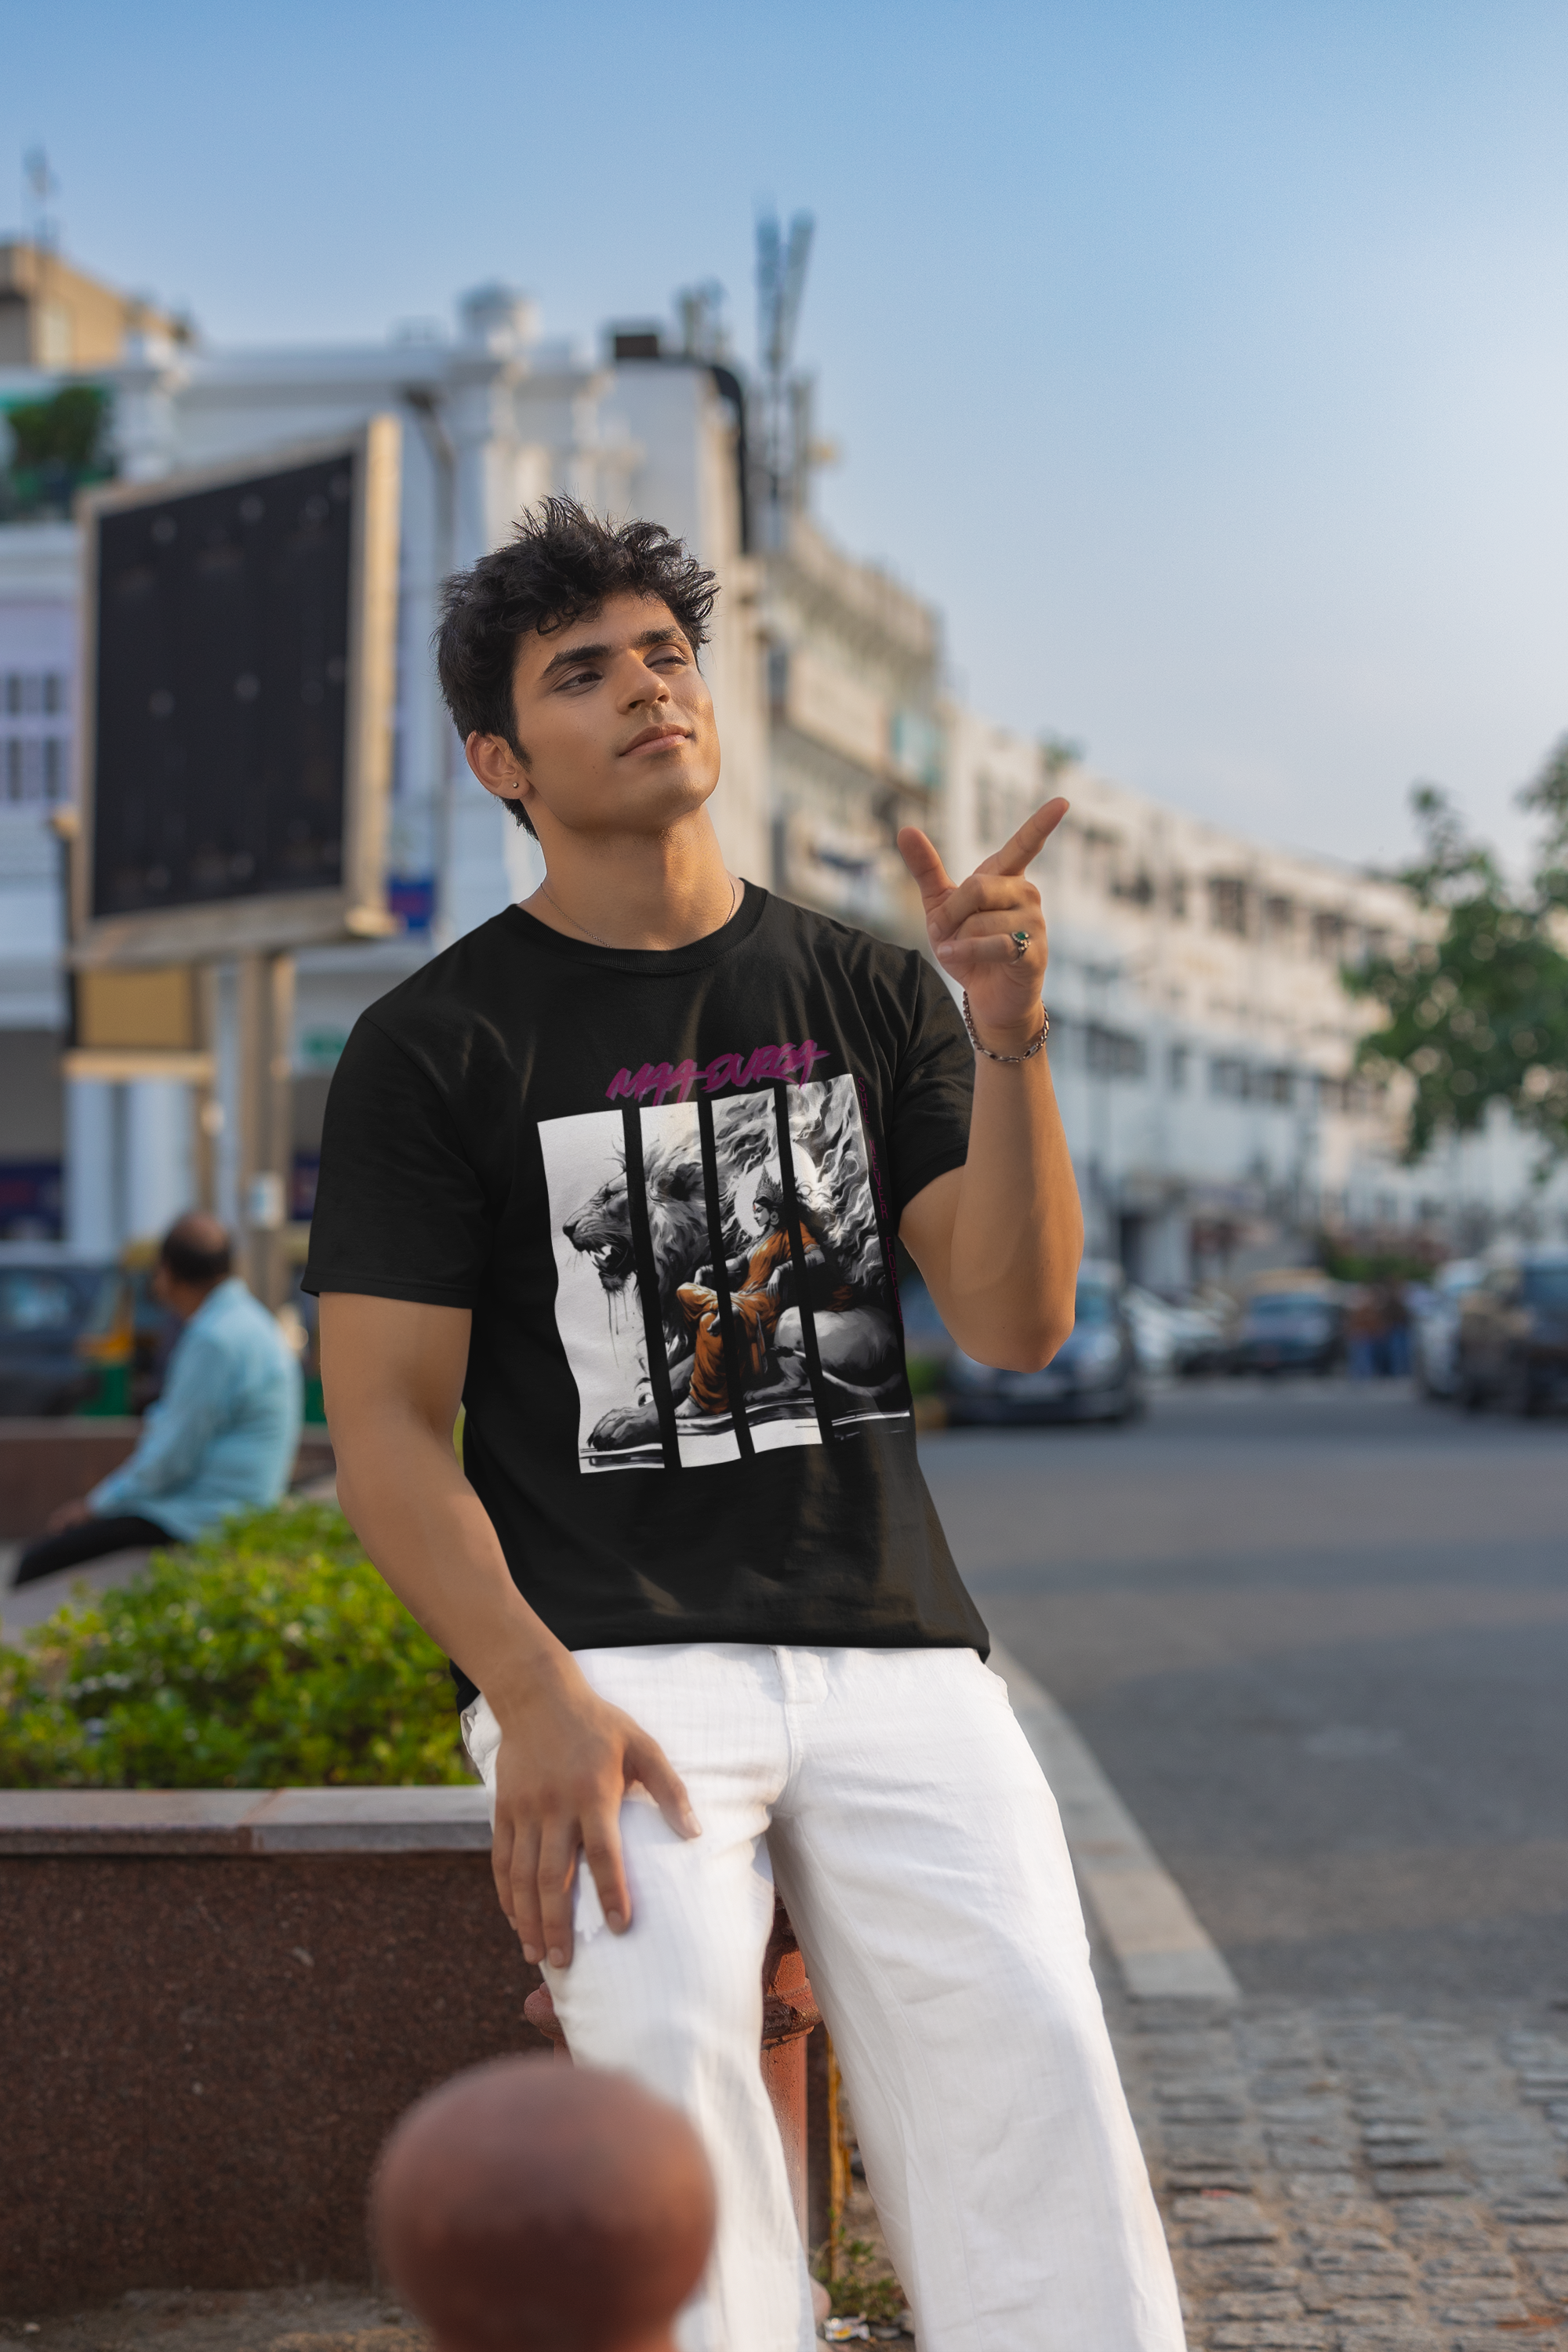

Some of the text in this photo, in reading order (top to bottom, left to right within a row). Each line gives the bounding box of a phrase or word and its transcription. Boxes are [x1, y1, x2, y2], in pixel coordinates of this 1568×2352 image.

[605, 1039, 831, 1108] MAA DURGA
[858, 1076, 870, 1123] SHE
[869, 1138, 889, 1220] NEVER
